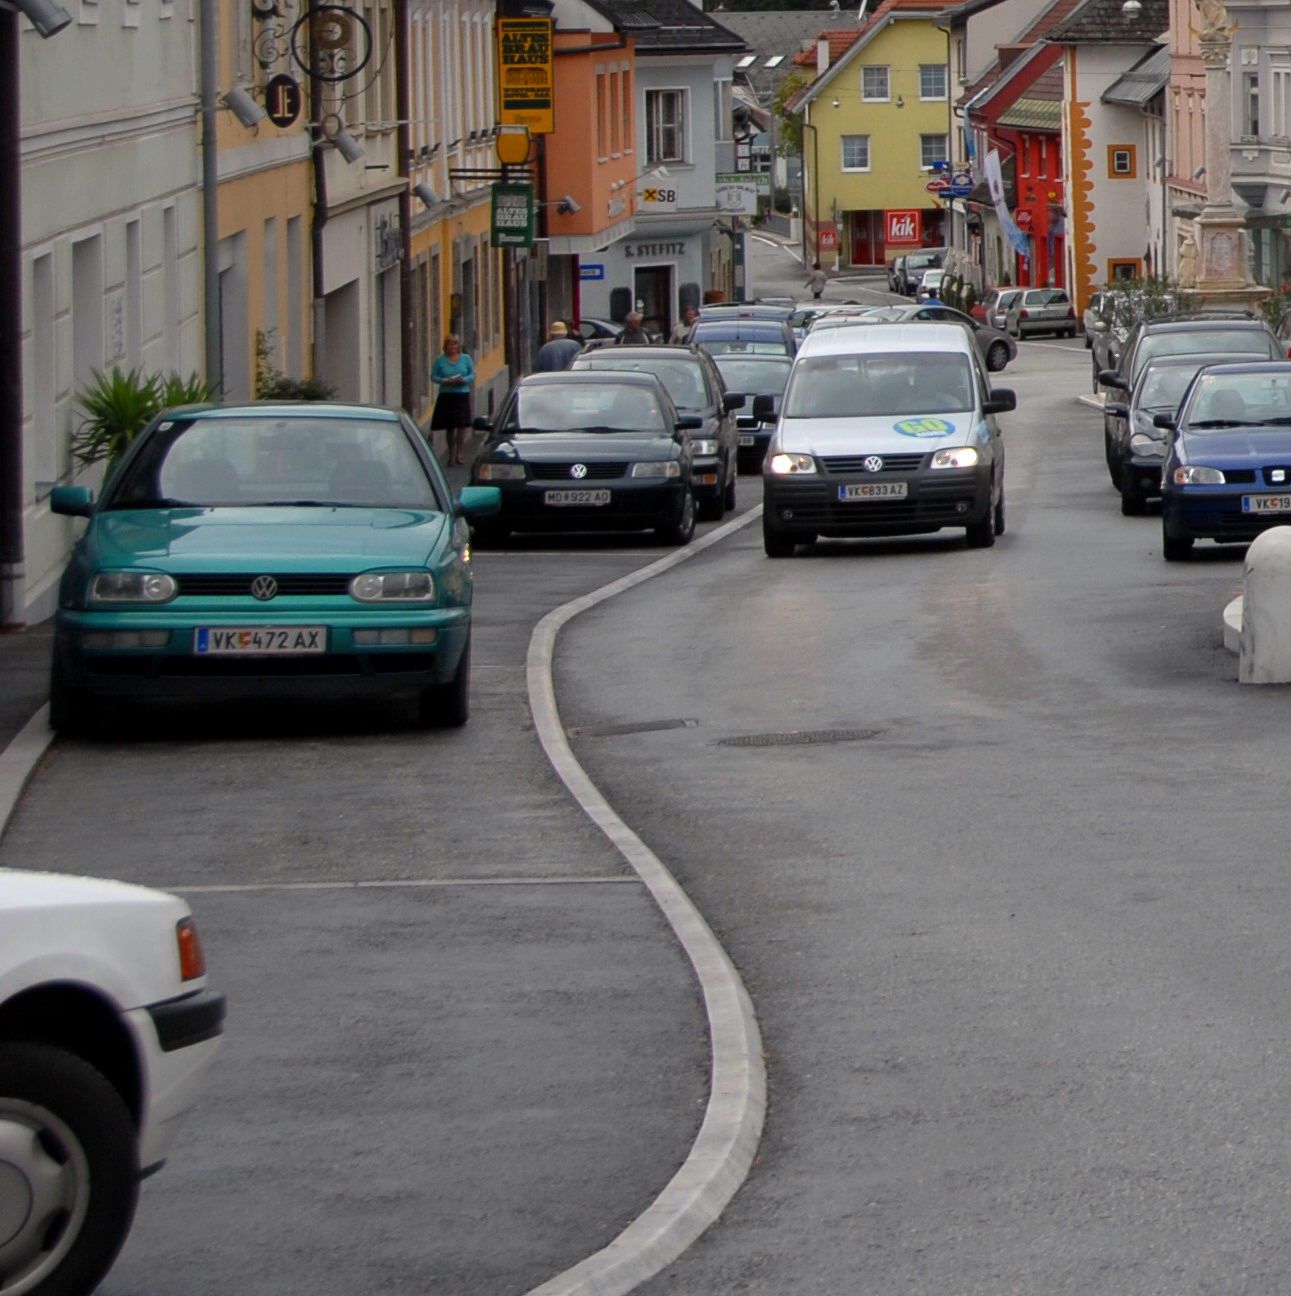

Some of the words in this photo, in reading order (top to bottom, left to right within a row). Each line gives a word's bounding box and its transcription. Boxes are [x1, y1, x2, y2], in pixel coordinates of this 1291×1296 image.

[657, 189, 676, 203] SB
[890, 214, 916, 237] kik
[847, 487, 861, 497] VK
[1255, 498, 1270, 510] VK
[213, 631, 236, 649] VK
[252, 631, 289, 649] 472
[294, 631, 319, 649] AX
